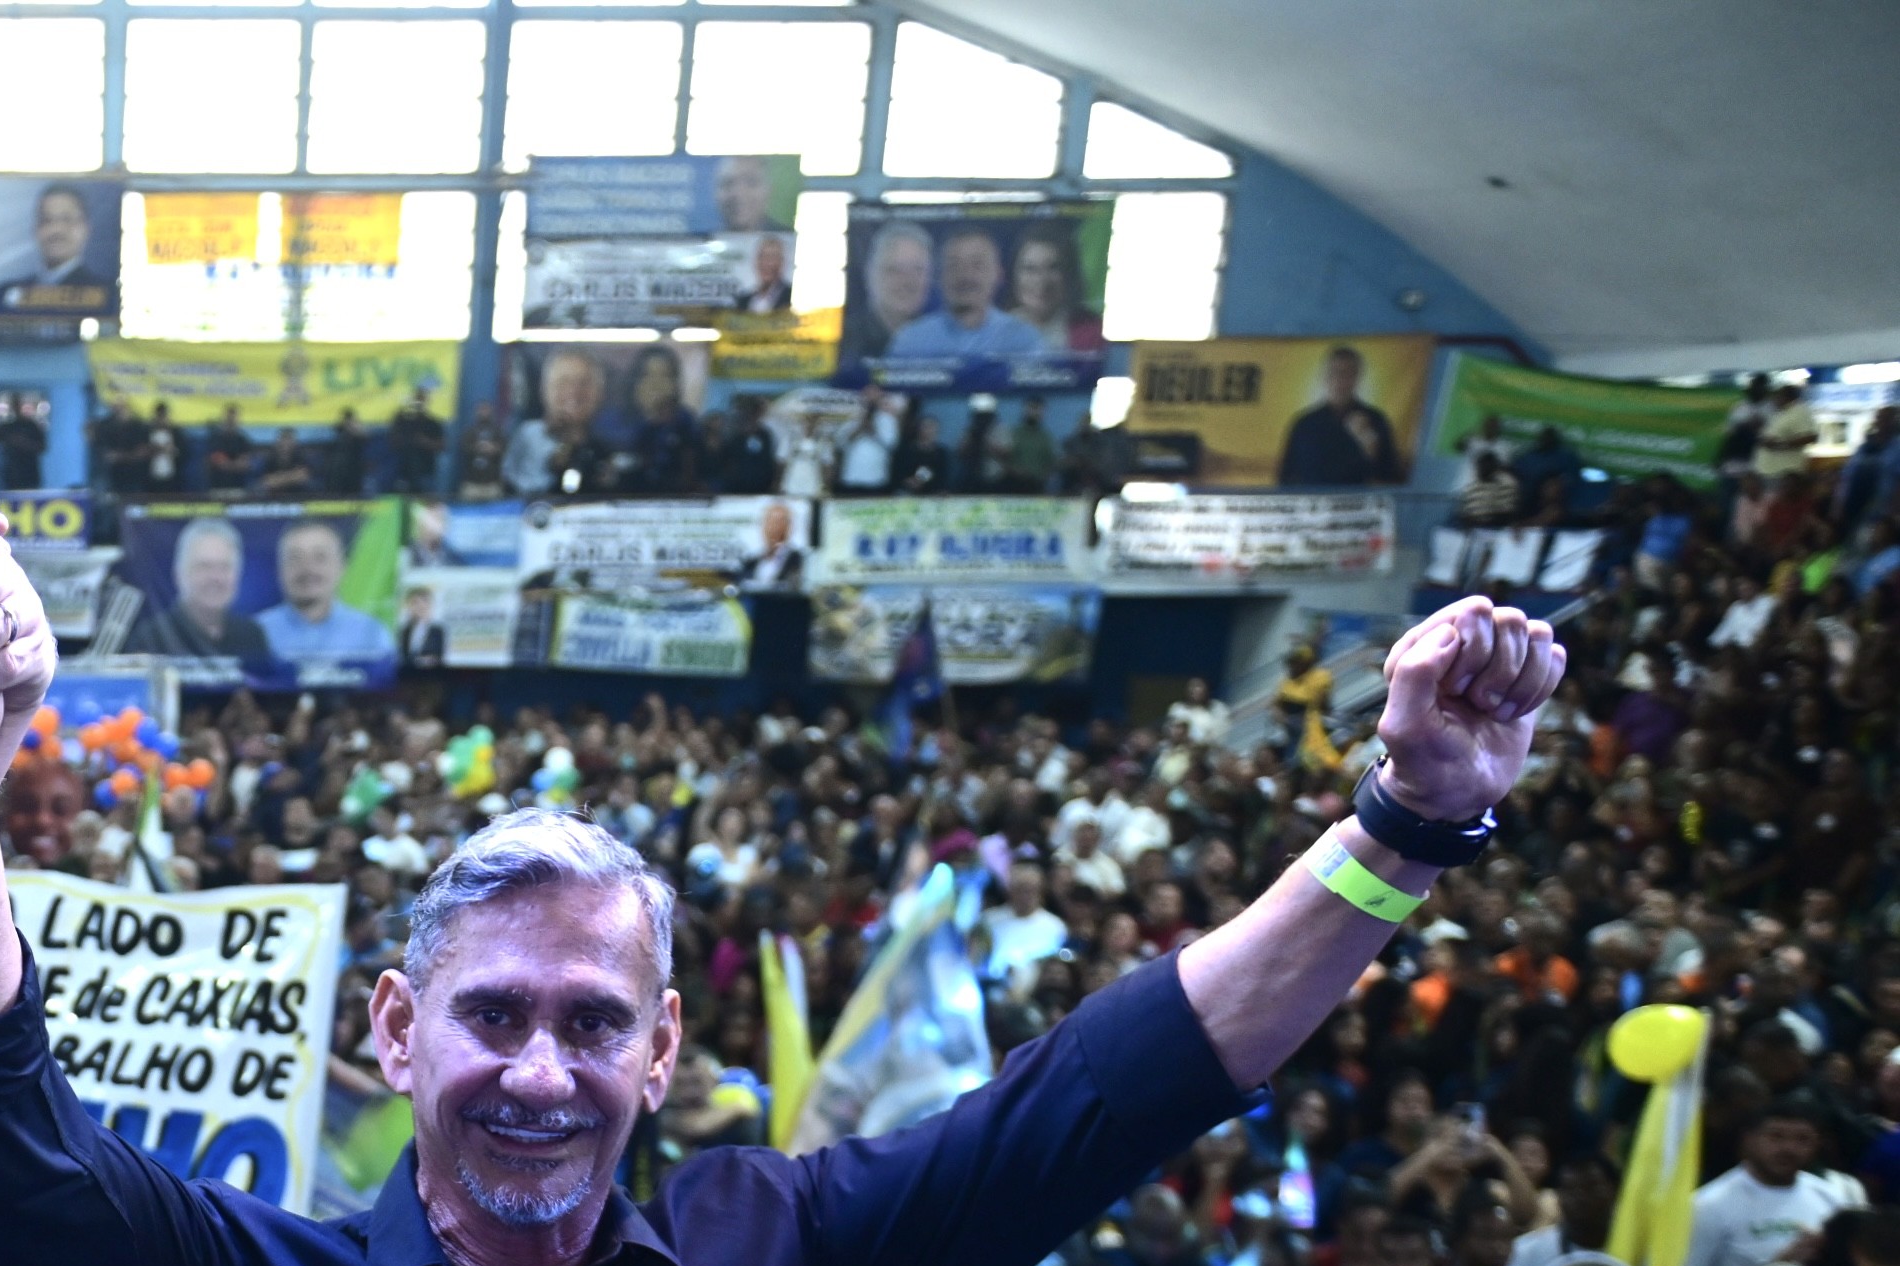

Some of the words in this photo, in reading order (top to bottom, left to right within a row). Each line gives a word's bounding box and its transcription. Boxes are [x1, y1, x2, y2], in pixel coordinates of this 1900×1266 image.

[40, 894, 184, 957] LADO
[220, 907, 288, 962] DE
[72, 966, 128, 1024] de
[230, 1048, 296, 1100] DE
